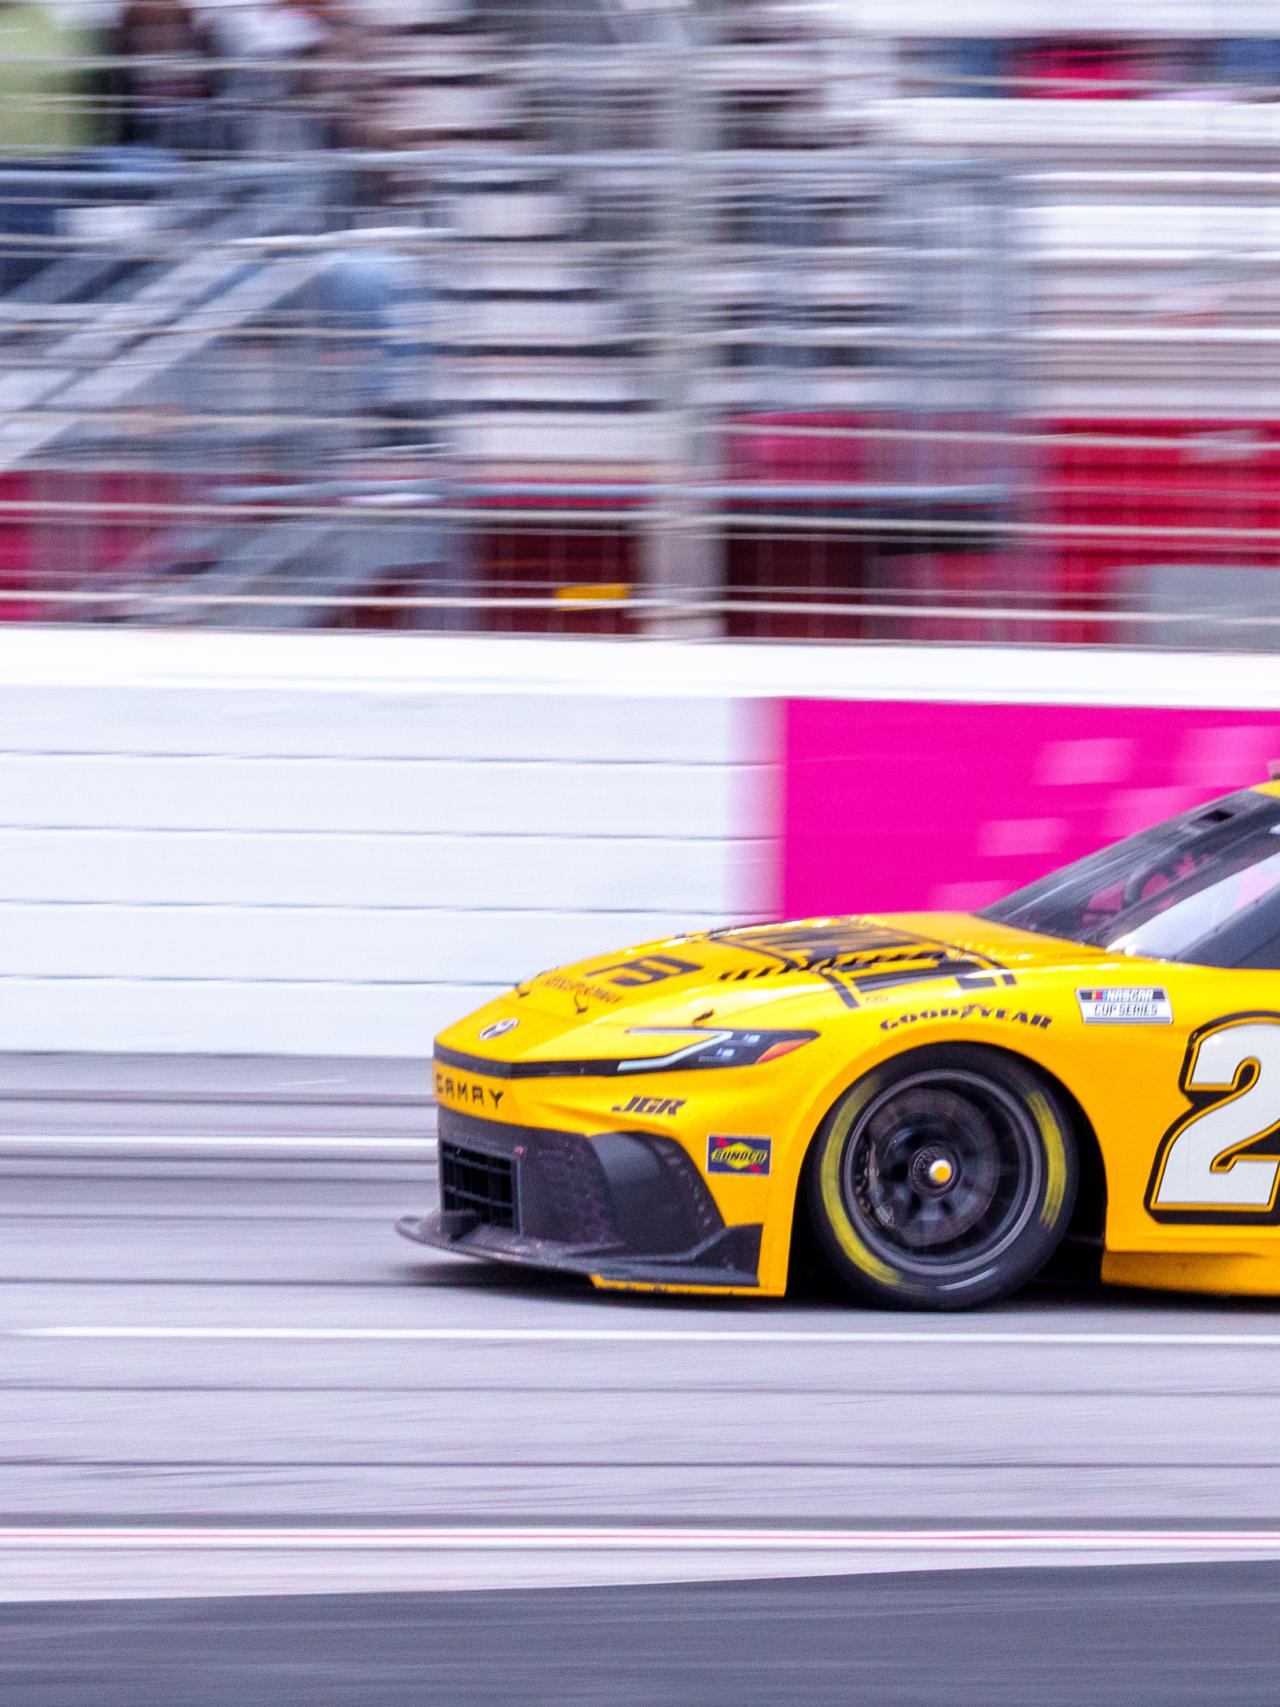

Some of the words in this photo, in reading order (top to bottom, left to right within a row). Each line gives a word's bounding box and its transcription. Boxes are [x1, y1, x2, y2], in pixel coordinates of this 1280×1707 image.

[1105, 986, 1154, 1003] NASCAR
[879, 1003, 1053, 1031] GOODYEAR
[1094, 1003, 1117, 1017] CUP
[1119, 1003, 1159, 1017] SERIES
[437, 1073, 504, 1109] CAMRY
[611, 1095, 687, 1116] JGR
[711, 1147, 768, 1164] SUNOCO
